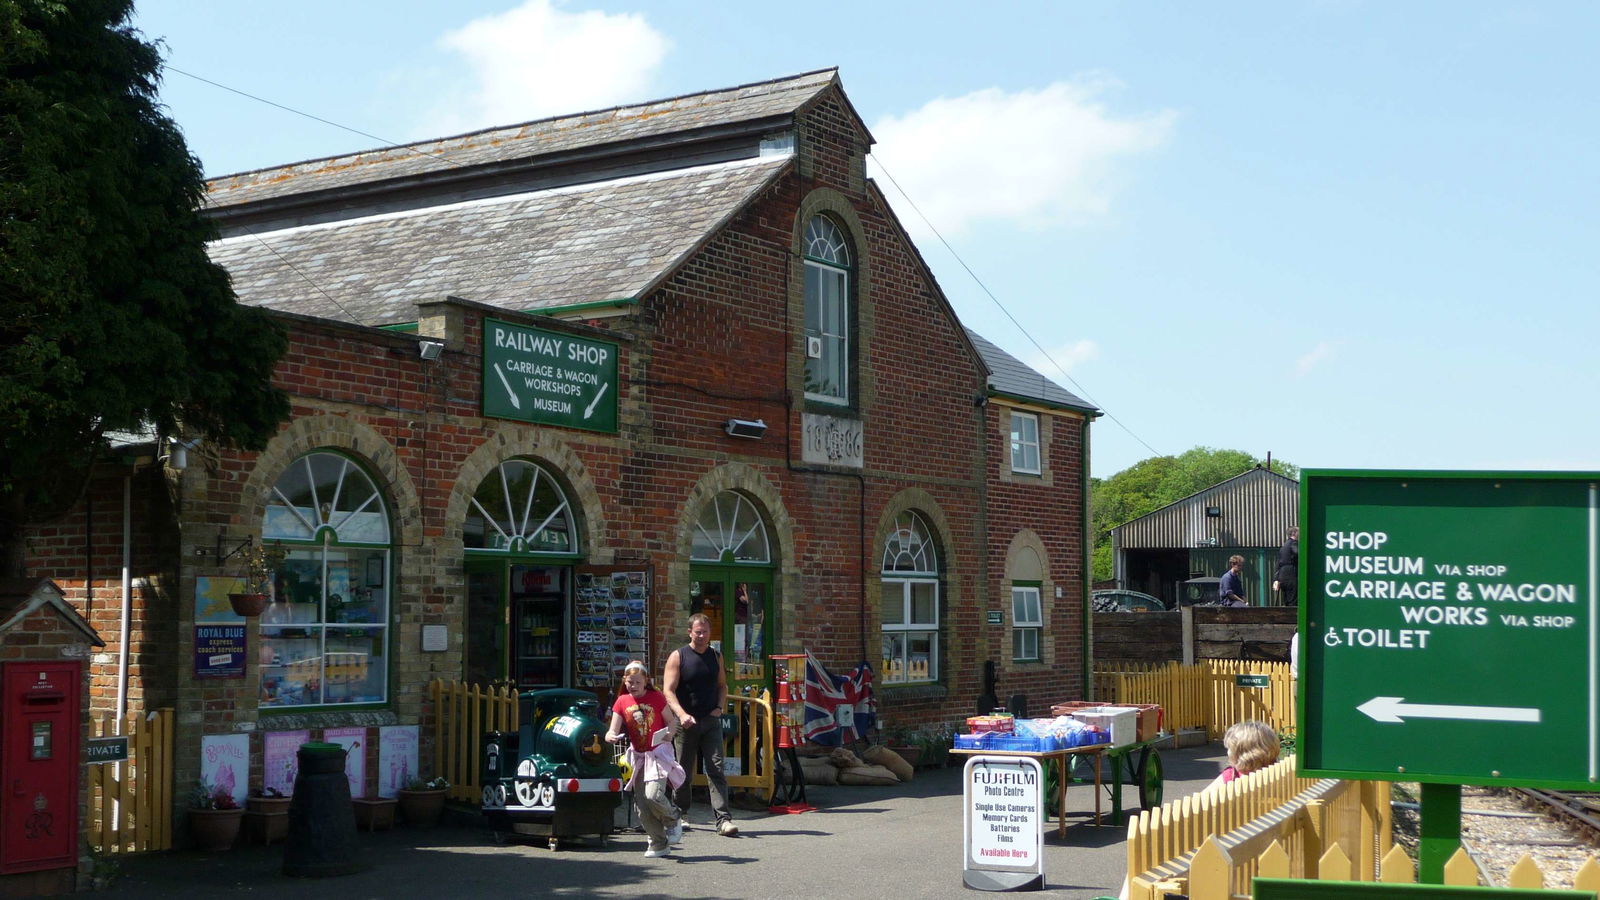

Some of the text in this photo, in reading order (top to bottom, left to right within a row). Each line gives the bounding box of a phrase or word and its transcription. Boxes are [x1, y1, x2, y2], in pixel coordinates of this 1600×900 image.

[495, 328, 608, 365] RAILWAY SHOP
[506, 360, 598, 385] CARRIAGE & WAGON
[525, 377, 581, 397] WORKSHOPS
[534, 398, 571, 414] MUSEUM
[1210, 537, 1216, 545] 2
[1325, 531, 1388, 550] SHOP
[1325, 555, 1506, 576] MUSEUM VIA SHOP
[1325, 580, 1576, 602] CARRIAGE & WAGON
[1401, 606, 1575, 628] WORKS VIA SHOP
[197, 628, 244, 638] ROYAL BLUE
[1343, 628, 1431, 648] TOILET
[218, 645, 244, 653] services
[88, 745, 120, 756] RIVATE
[974, 772, 1035, 785] FUJIFILM
[984, 786, 1024, 797] Photo Centre
[975, 803, 1035, 813] Single Use Cameras
[982, 813, 1028, 823] Memory Cards
[990, 824, 1020, 833] Batteries
[997, 834, 1013, 843] Films
[980, 848, 1028, 858] Available Here
